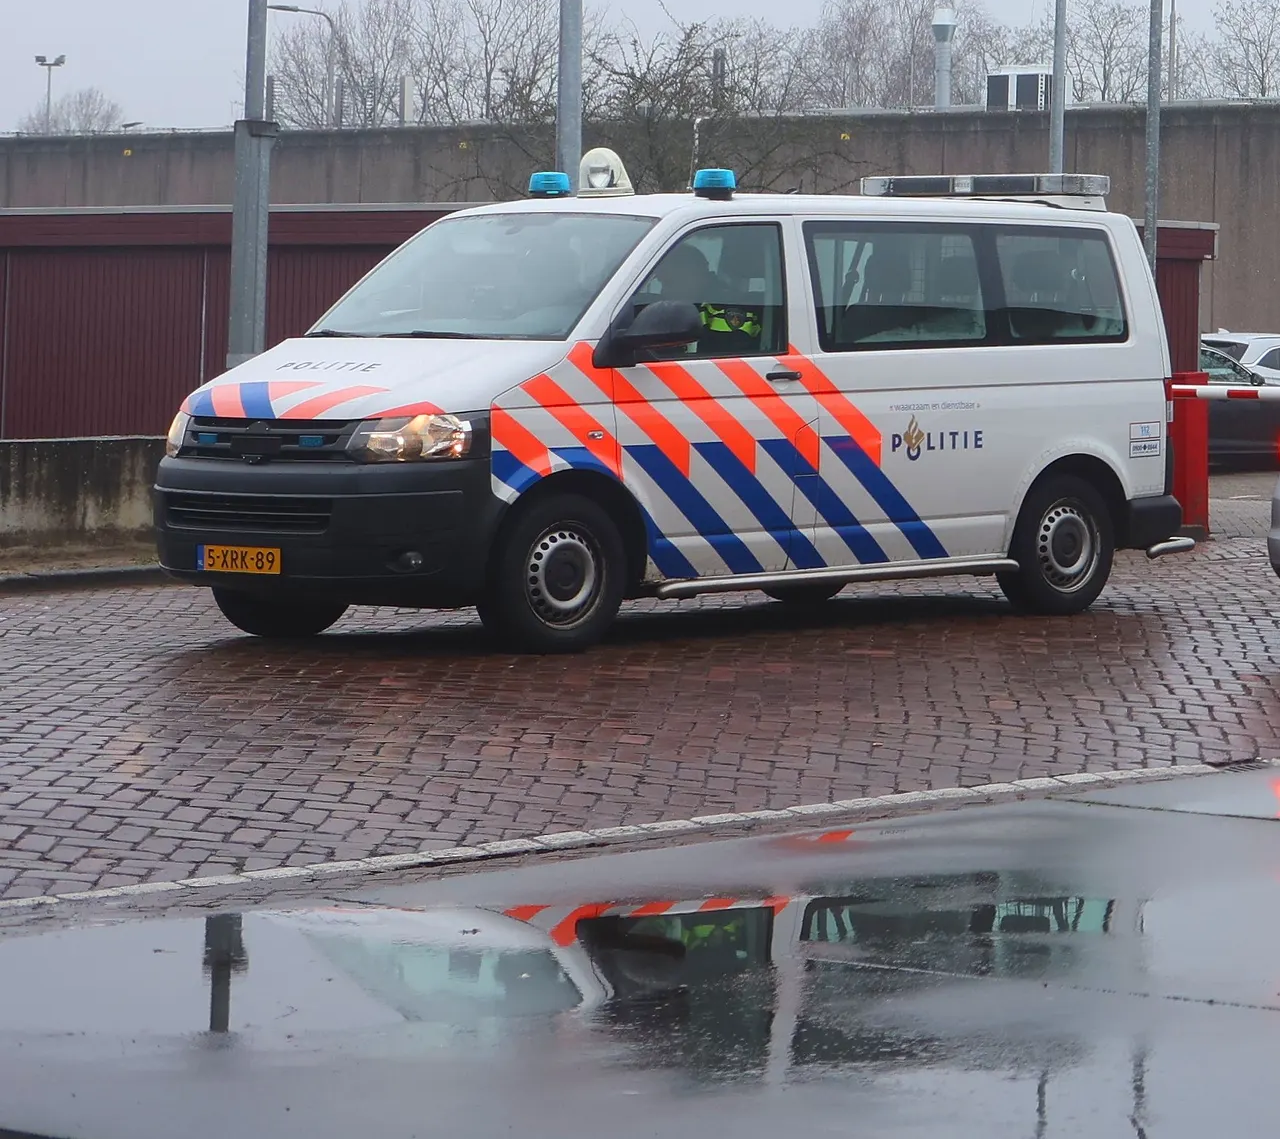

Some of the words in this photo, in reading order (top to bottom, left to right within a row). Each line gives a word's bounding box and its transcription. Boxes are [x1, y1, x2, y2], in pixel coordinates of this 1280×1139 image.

[276, 361, 382, 373] POLITIE
[931, 402, 940, 410] en
[941, 400, 975, 410] dienstbaar
[891, 430, 983, 461] POLITIE
[208, 548, 275, 571] 5-XRK-89
